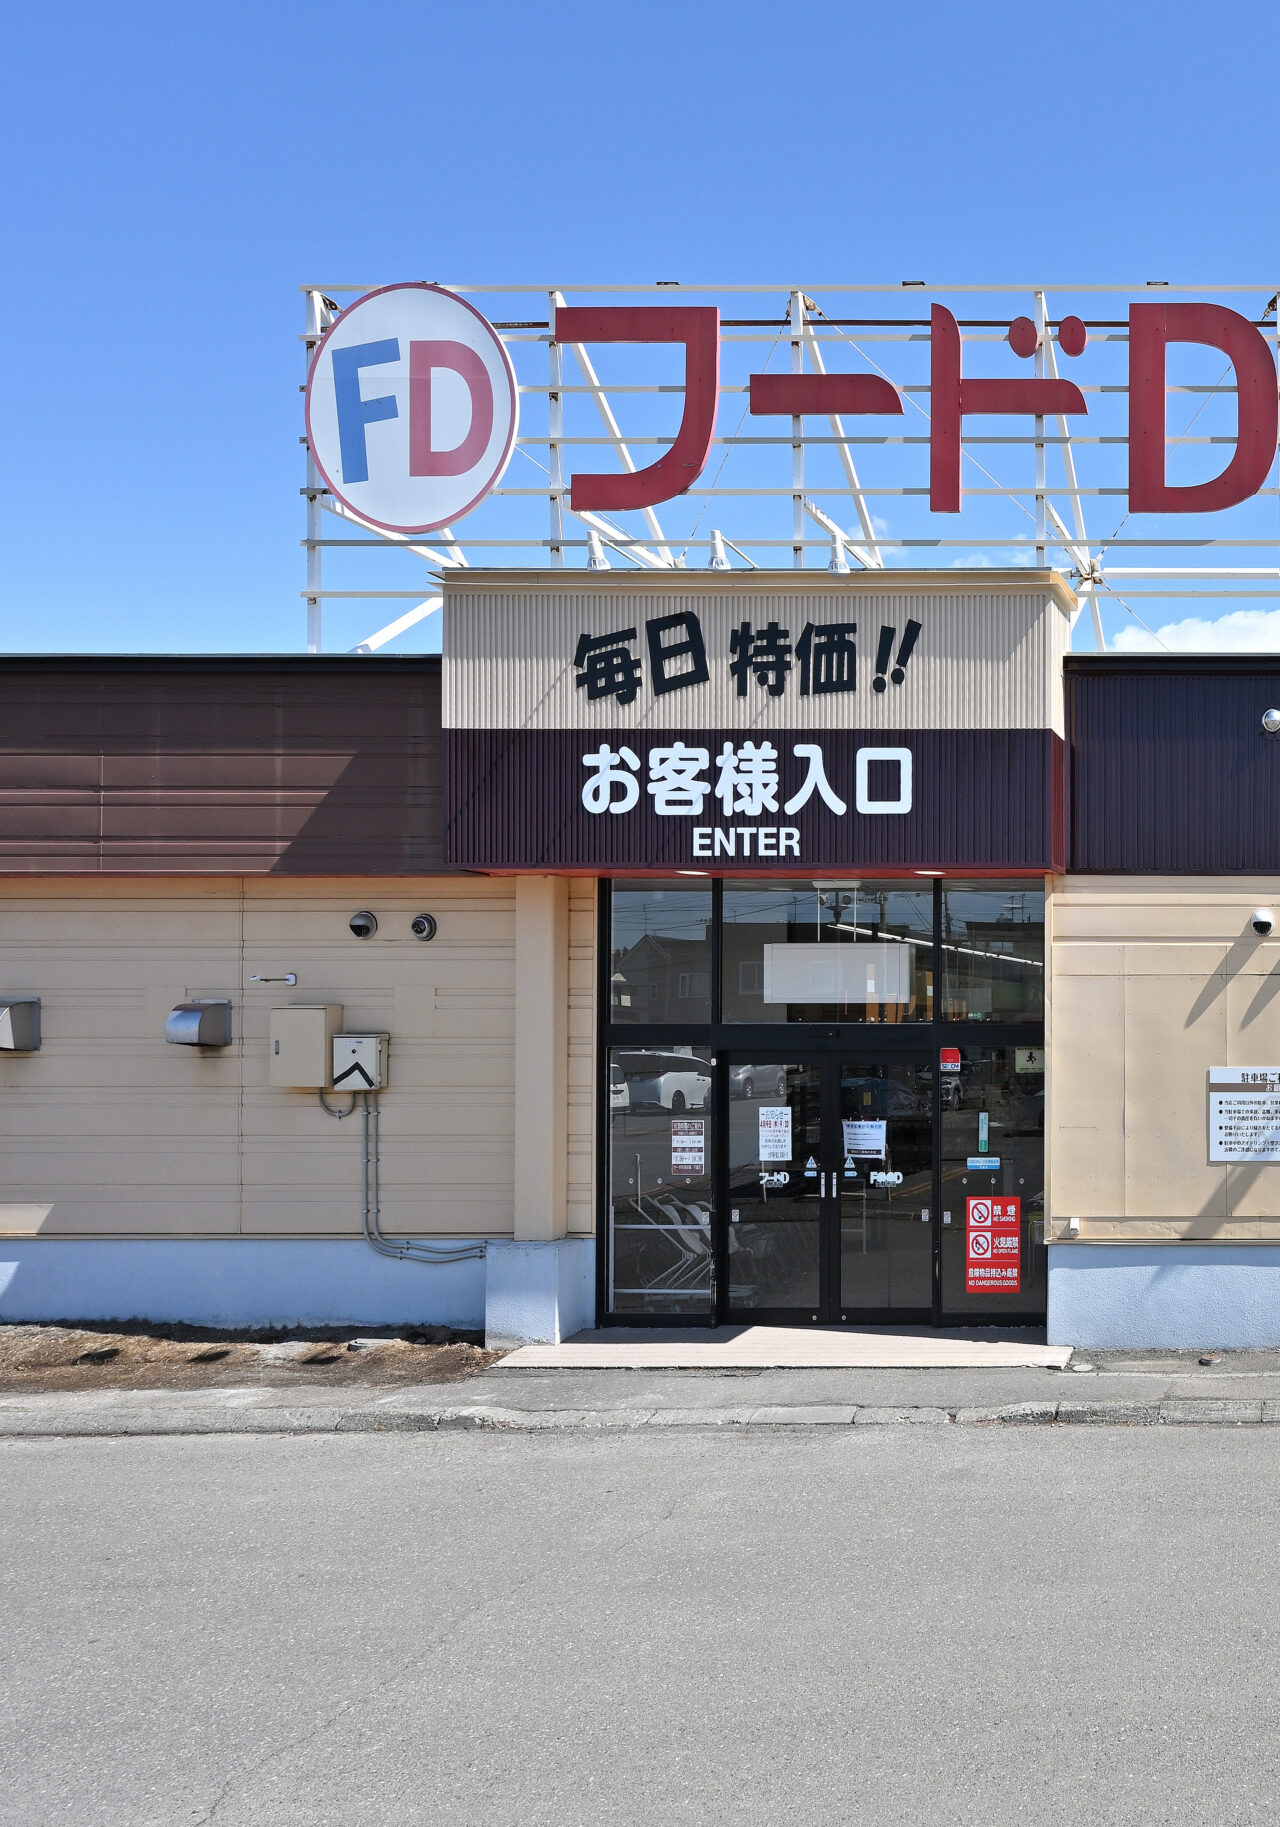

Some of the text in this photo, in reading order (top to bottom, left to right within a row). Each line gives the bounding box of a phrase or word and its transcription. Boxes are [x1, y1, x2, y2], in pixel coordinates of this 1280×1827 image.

[331, 336, 494, 484] FD
[556, 302, 1279, 514] フードD
[582, 741, 912, 816] お客様入口
[693, 827, 800, 857] ENTER
[993, 1237, 1018, 1247] 火気厳禁
[968, 1268, 1018, 1277] 危険物品持込み厳禁
